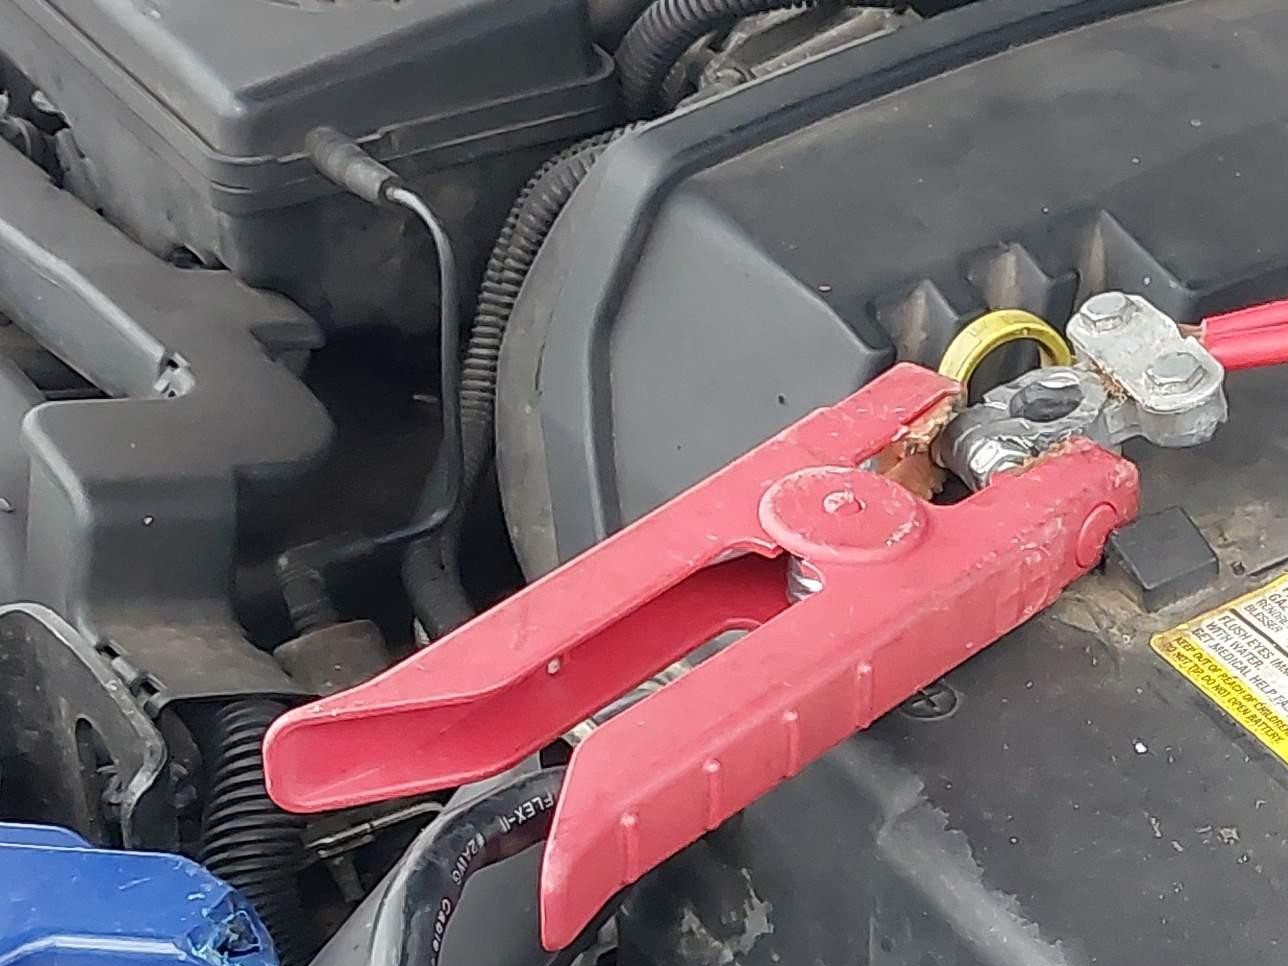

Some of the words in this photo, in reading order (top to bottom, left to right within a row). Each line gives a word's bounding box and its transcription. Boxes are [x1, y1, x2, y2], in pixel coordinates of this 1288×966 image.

[1189, 626, 1217, 646] GET
[1207, 641, 1255, 677] MEDICAL
[1246, 673, 1279, 698] HELP
[1203, 620, 1235, 643] WITH
[1227, 640, 1268, 671] WATER.
[1215, 613, 1254, 641] FLUSH
[1244, 638, 1276, 660] EYES
[1172, 635, 1198, 654] KEEP
[1190, 651, 1212, 666] OUT
[1205, 663, 1223, 675] OF
[1216, 671, 1247, 695] REACH
[1240, 692, 1258, 705] OF
[1199, 673, 1217, 686] DO
[1210, 683, 1231, 698] NOT
[1226, 695, 1252, 716] OPEN
